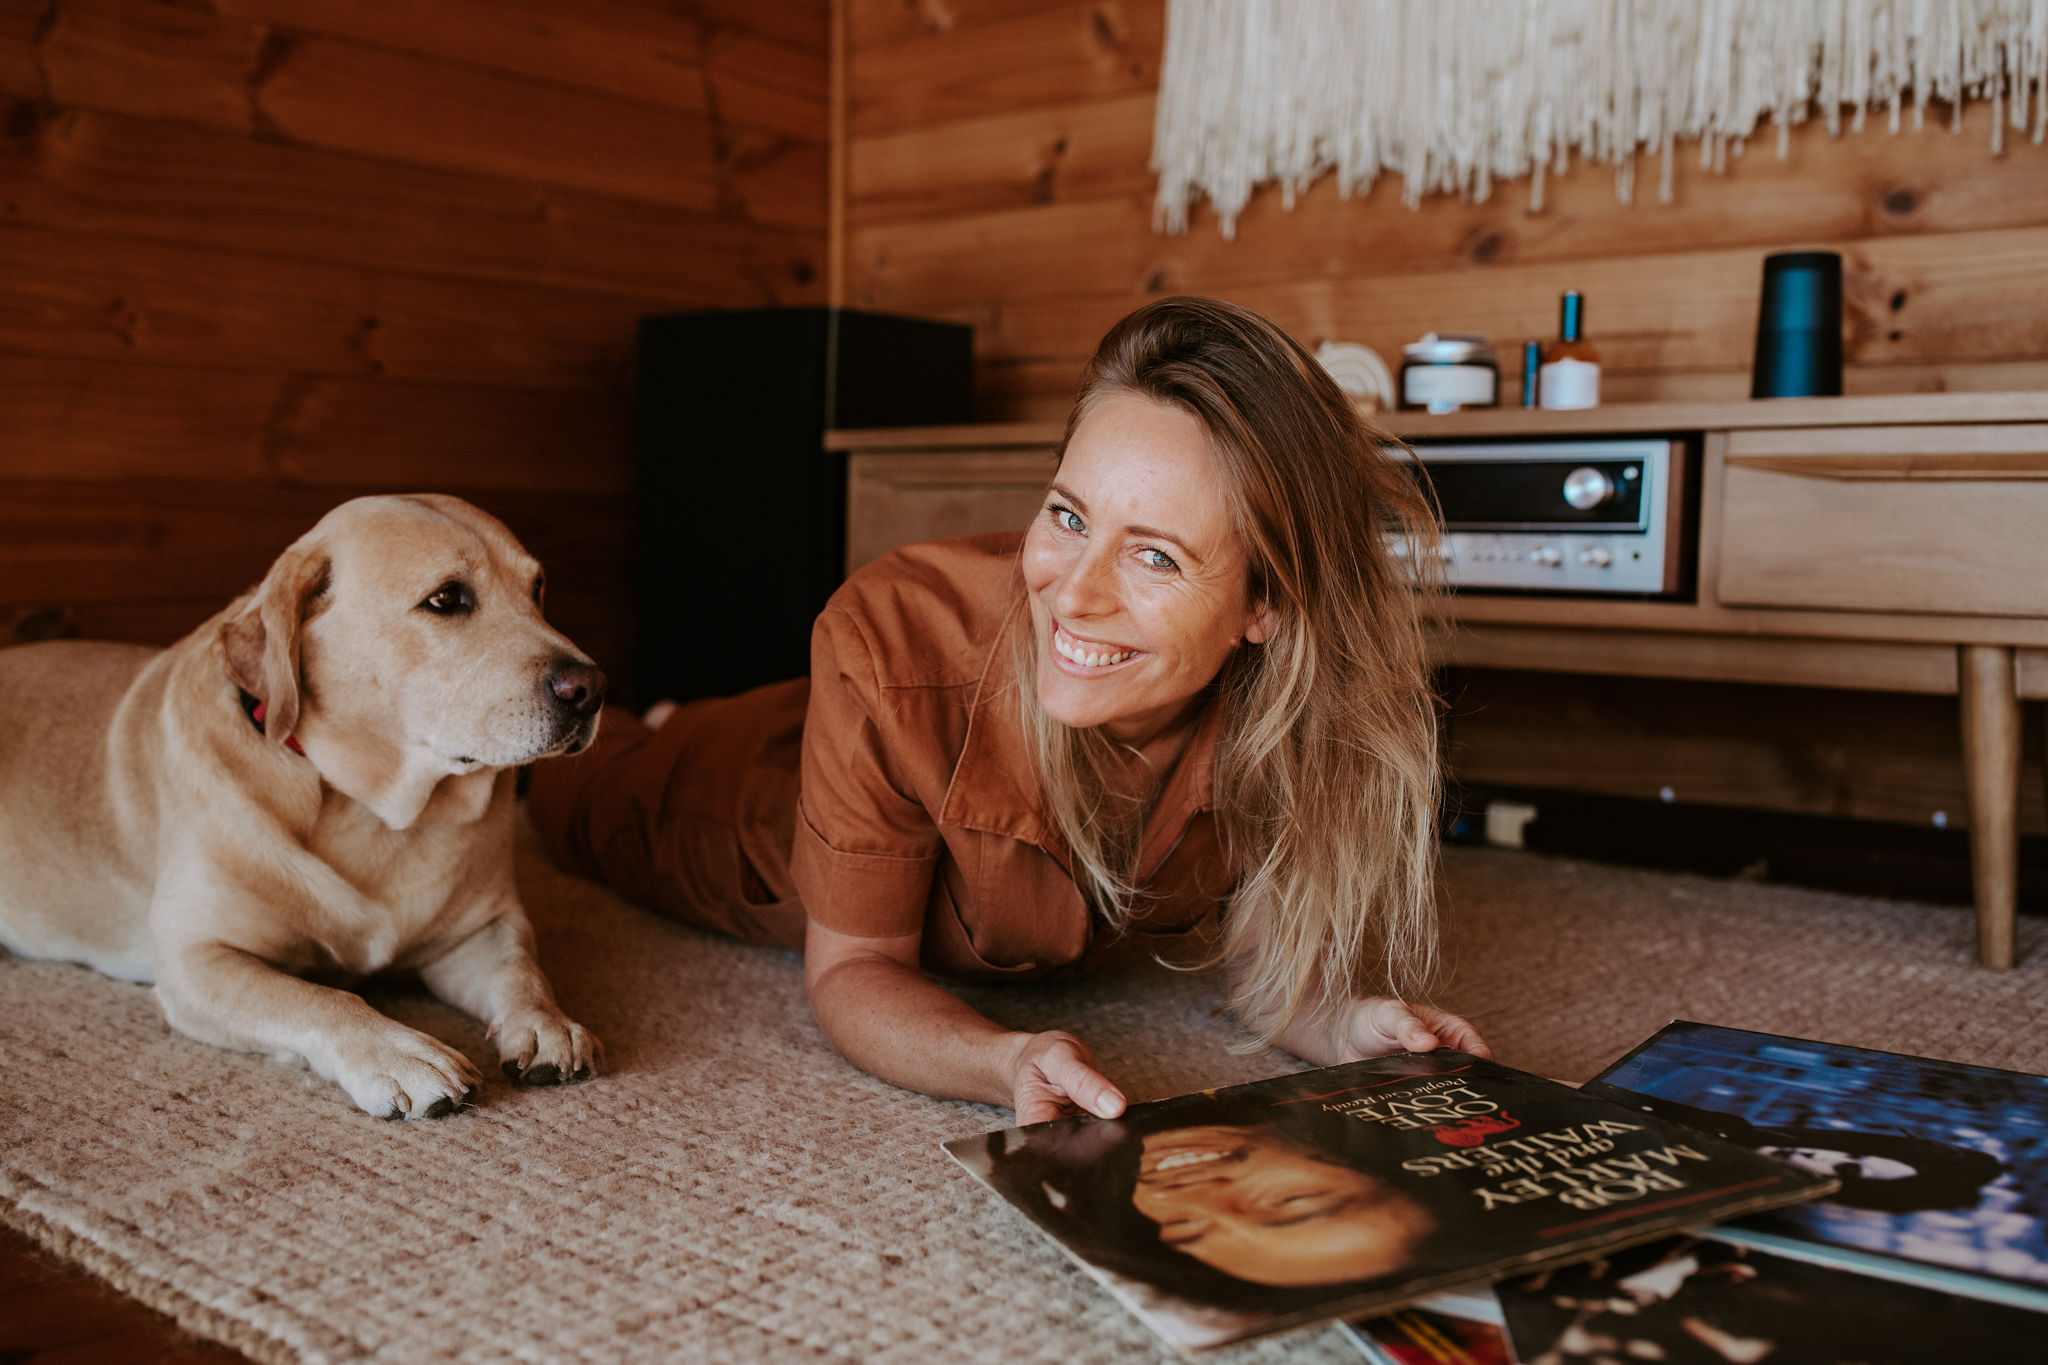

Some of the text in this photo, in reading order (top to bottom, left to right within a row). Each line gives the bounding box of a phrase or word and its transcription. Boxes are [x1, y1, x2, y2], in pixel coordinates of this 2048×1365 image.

[1320, 1077, 1467, 1113] People Get Ready
[1346, 1087, 1488, 1122] LOVE
[1381, 1100, 1498, 1131] ONE
[1402, 1119, 1644, 1177] WAILERS
[1485, 1138, 1614, 1179] and the
[1474, 1145, 1709, 1210] MARLEY
[1559, 1174, 1688, 1210] BOB
